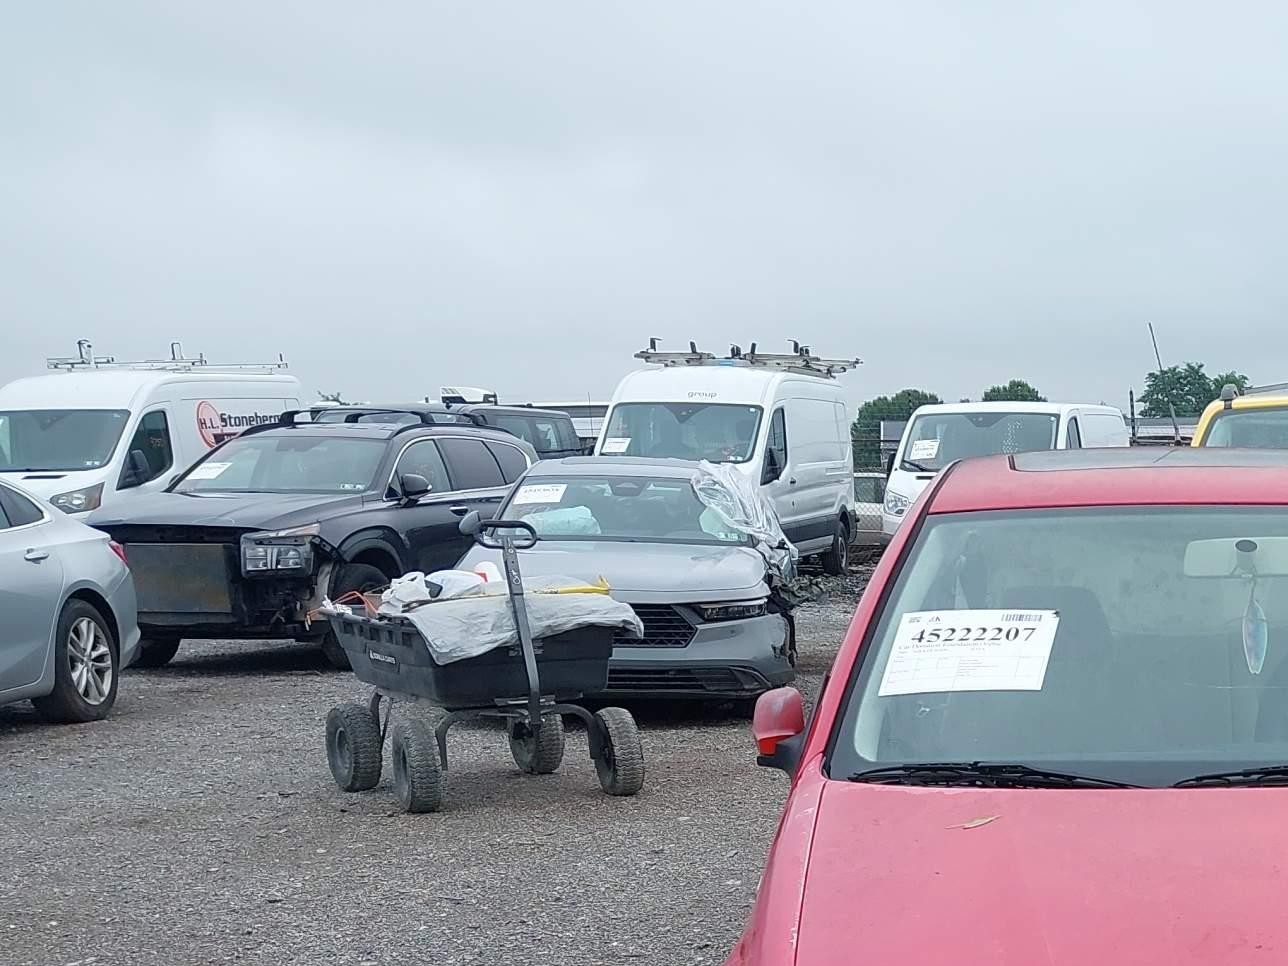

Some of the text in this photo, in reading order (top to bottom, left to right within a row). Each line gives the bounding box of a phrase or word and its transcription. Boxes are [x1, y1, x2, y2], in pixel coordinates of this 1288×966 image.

[687, 391, 718, 399] group
[200, 417, 220, 430] H.L.
[911, 627, 1037, 643] 45222207
